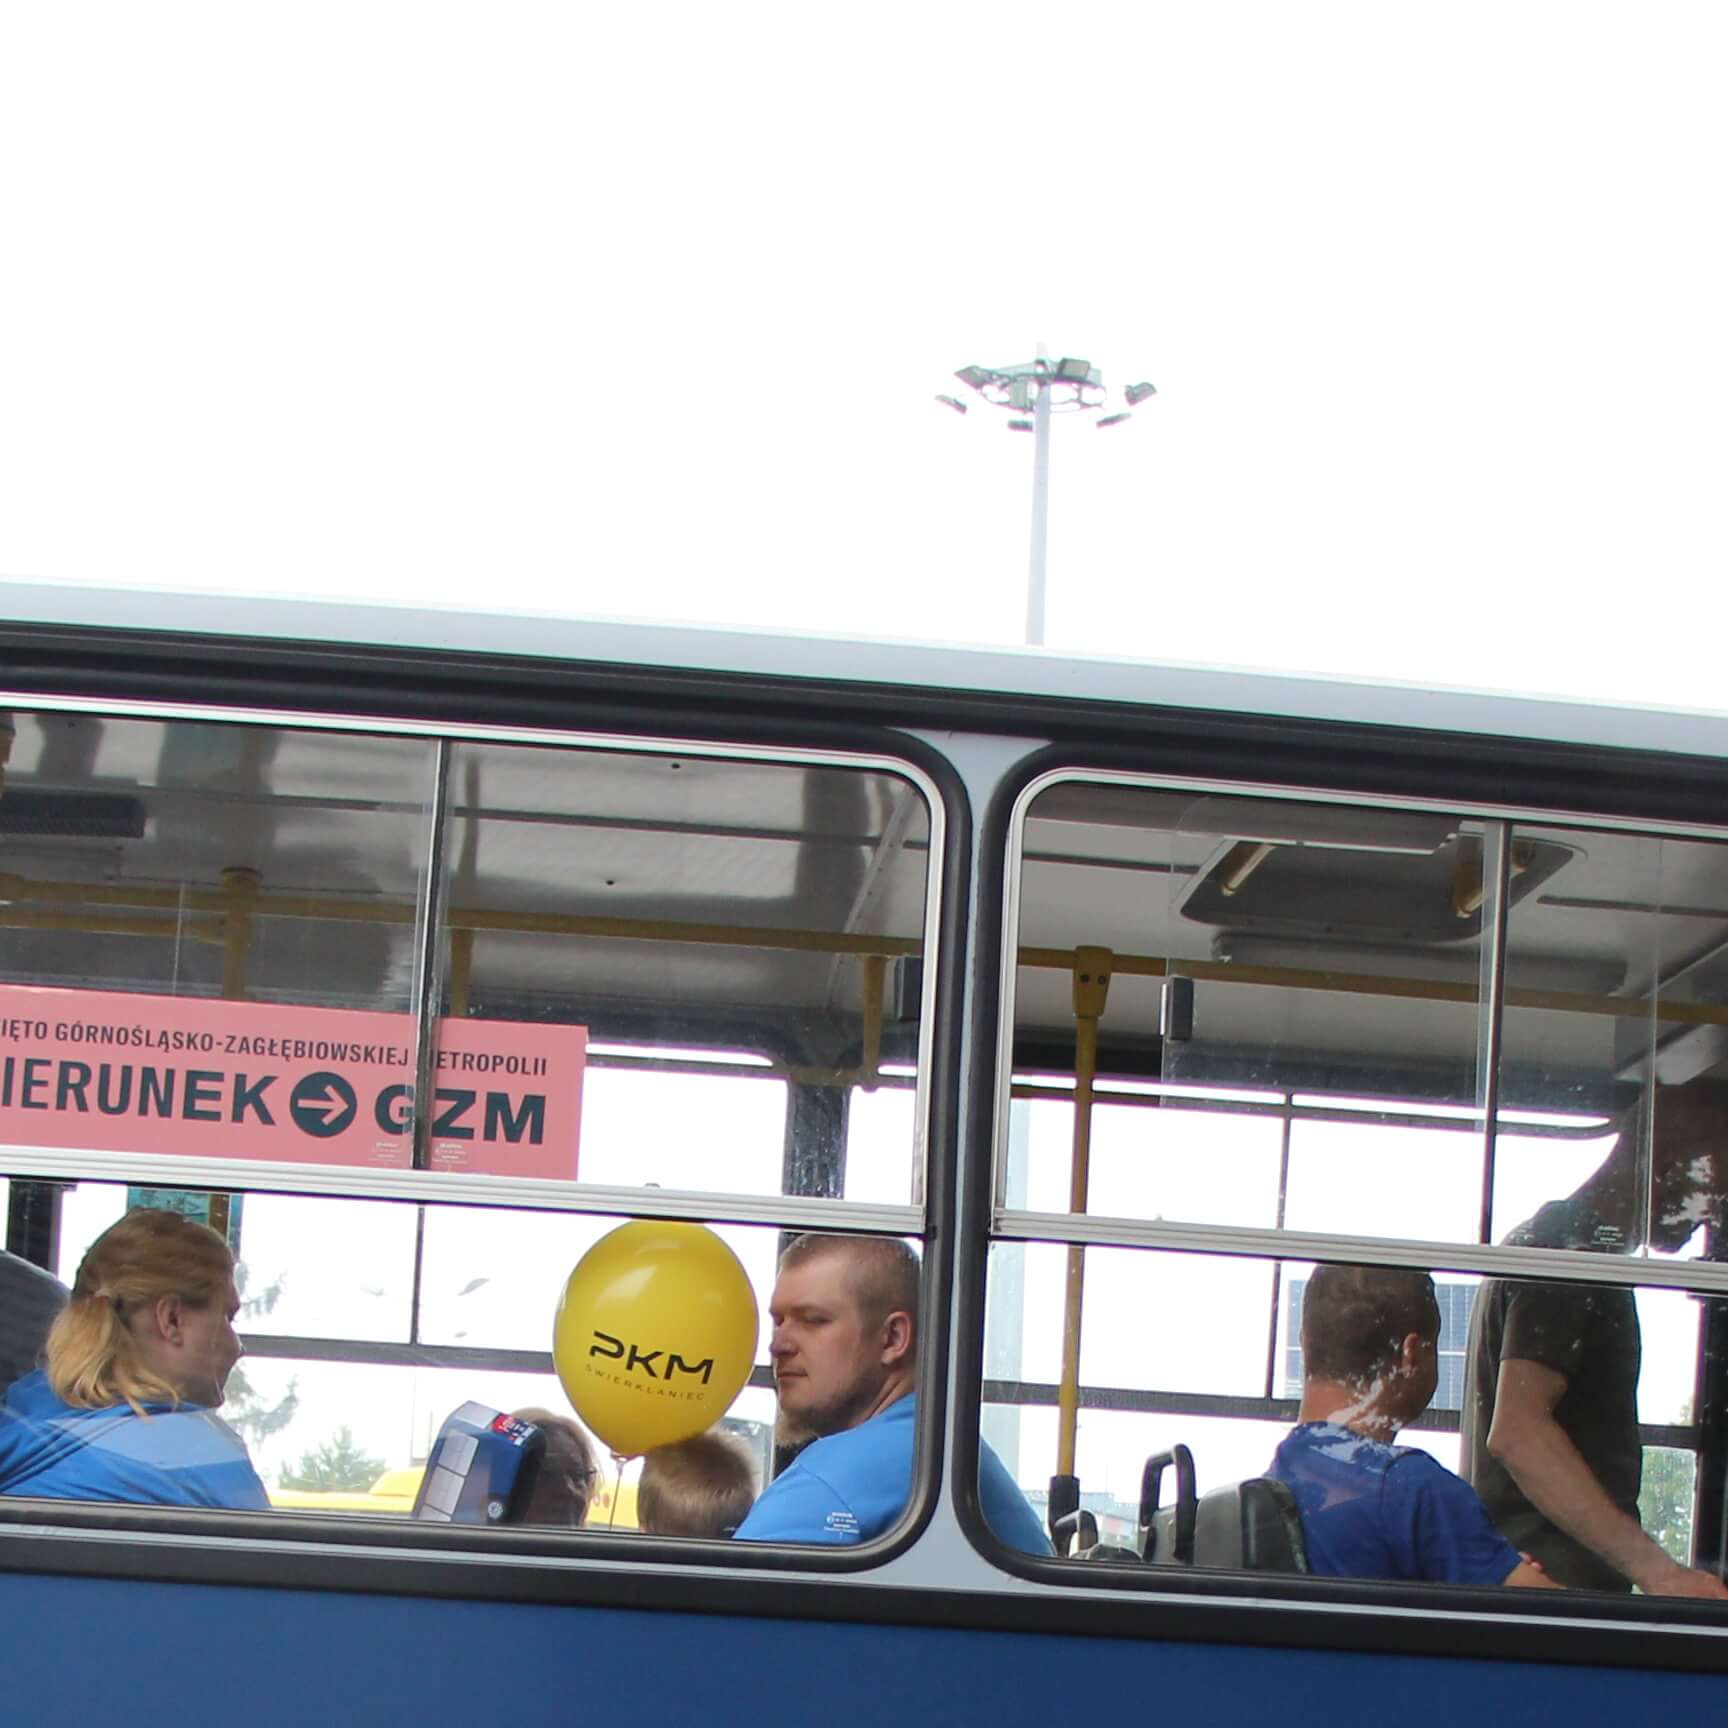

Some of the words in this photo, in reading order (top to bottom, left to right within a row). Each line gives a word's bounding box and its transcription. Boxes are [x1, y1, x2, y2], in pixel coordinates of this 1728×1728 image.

[55, 1020, 409, 1067] GÓRNOŚLĄSKO-ZAGŁĘBIOWSKIEJ
[374, 1083, 547, 1145] GZM
[589, 1330, 714, 1385] PKM
